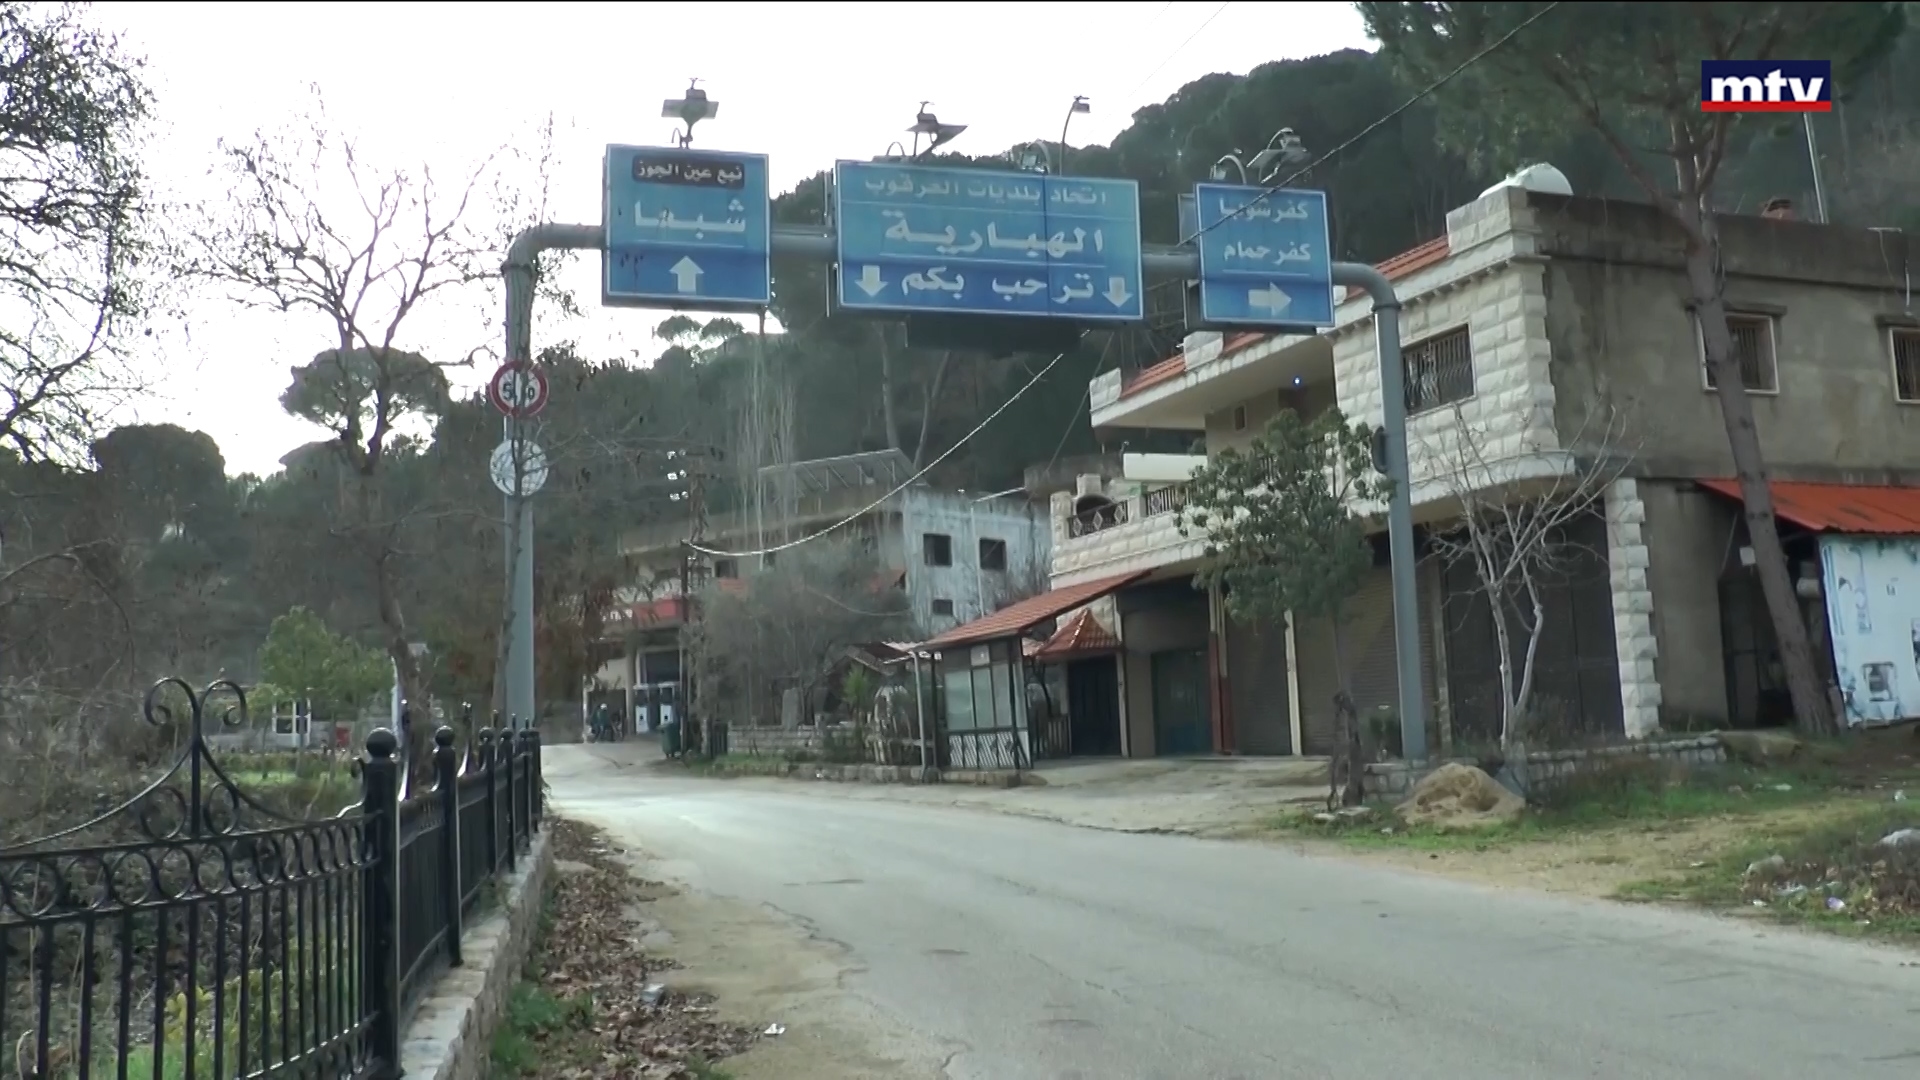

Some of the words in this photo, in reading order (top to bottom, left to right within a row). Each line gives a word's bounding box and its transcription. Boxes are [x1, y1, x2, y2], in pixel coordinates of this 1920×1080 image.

[637, 160, 679, 179] الجوز
[683, 164, 712, 182] عين
[717, 165, 743, 184] نبع
[865, 174, 960, 198] العرقوب
[967, 180, 1041, 206] بلديات
[1051, 184, 1106, 205] اتحاد
[634, 199, 746, 240] شبعا
[881, 209, 1105, 259] الهبارية
[901, 265, 965, 300] بكم
[991, 271, 1094, 304] ترحب
